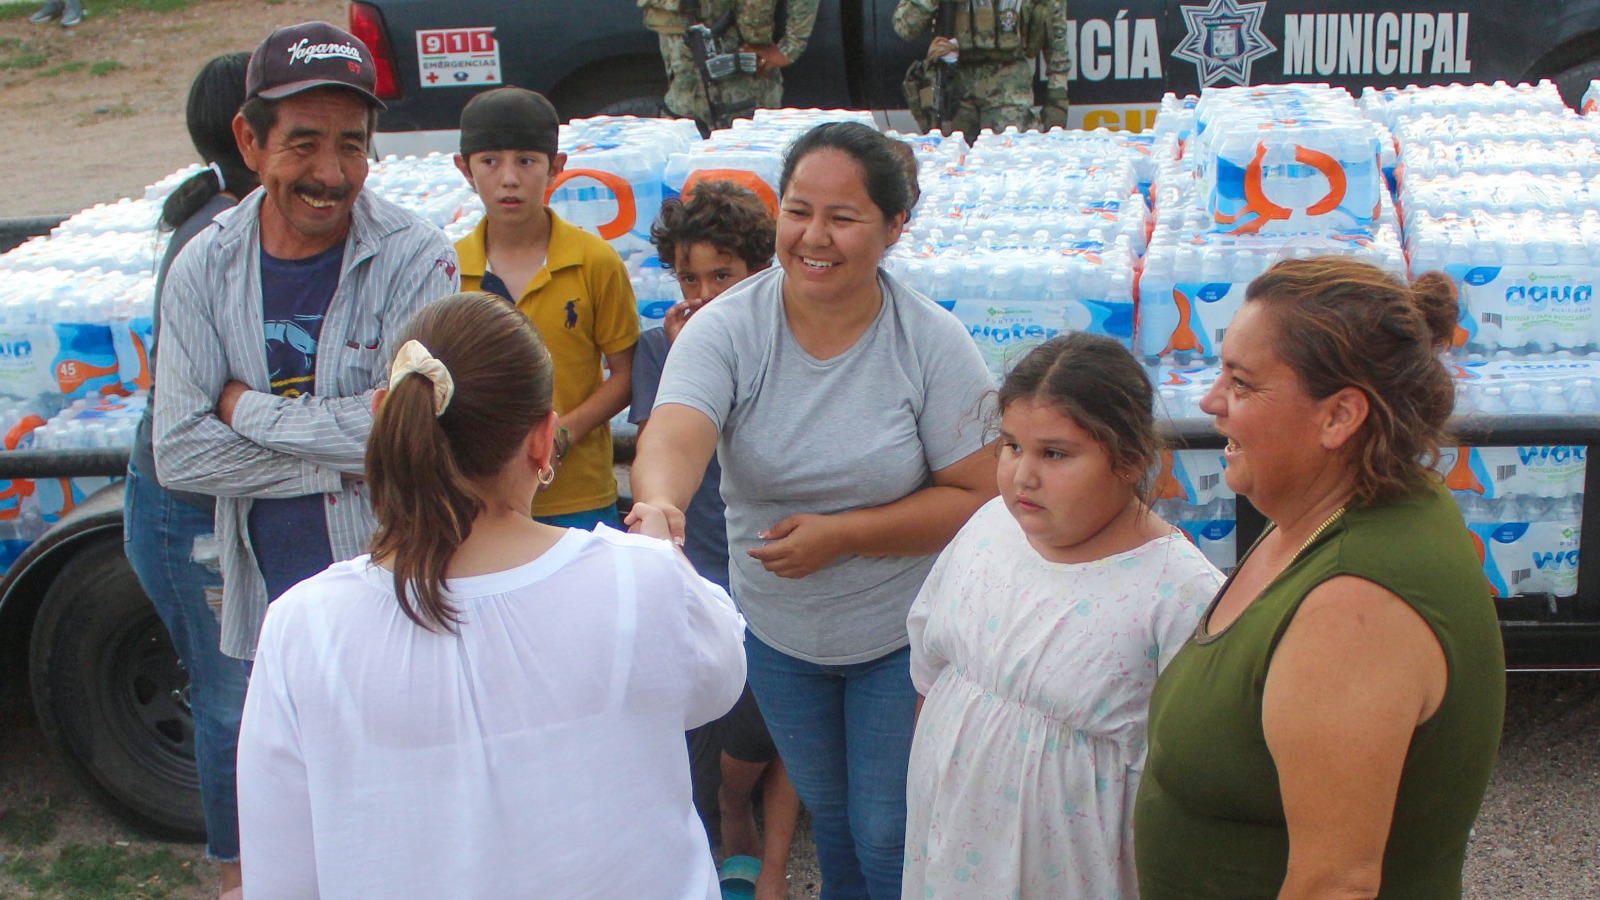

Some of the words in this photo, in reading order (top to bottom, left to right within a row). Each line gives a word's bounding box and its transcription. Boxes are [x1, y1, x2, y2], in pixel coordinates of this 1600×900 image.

[287, 38, 362, 65] Vagancia
[426, 33, 487, 52] 911
[1283, 12, 1471, 75] MUNICIPAL
[423, 59, 496, 69] EMERGENCIAS
[1505, 285, 1592, 310] agua
[60, 363, 77, 375] 45
